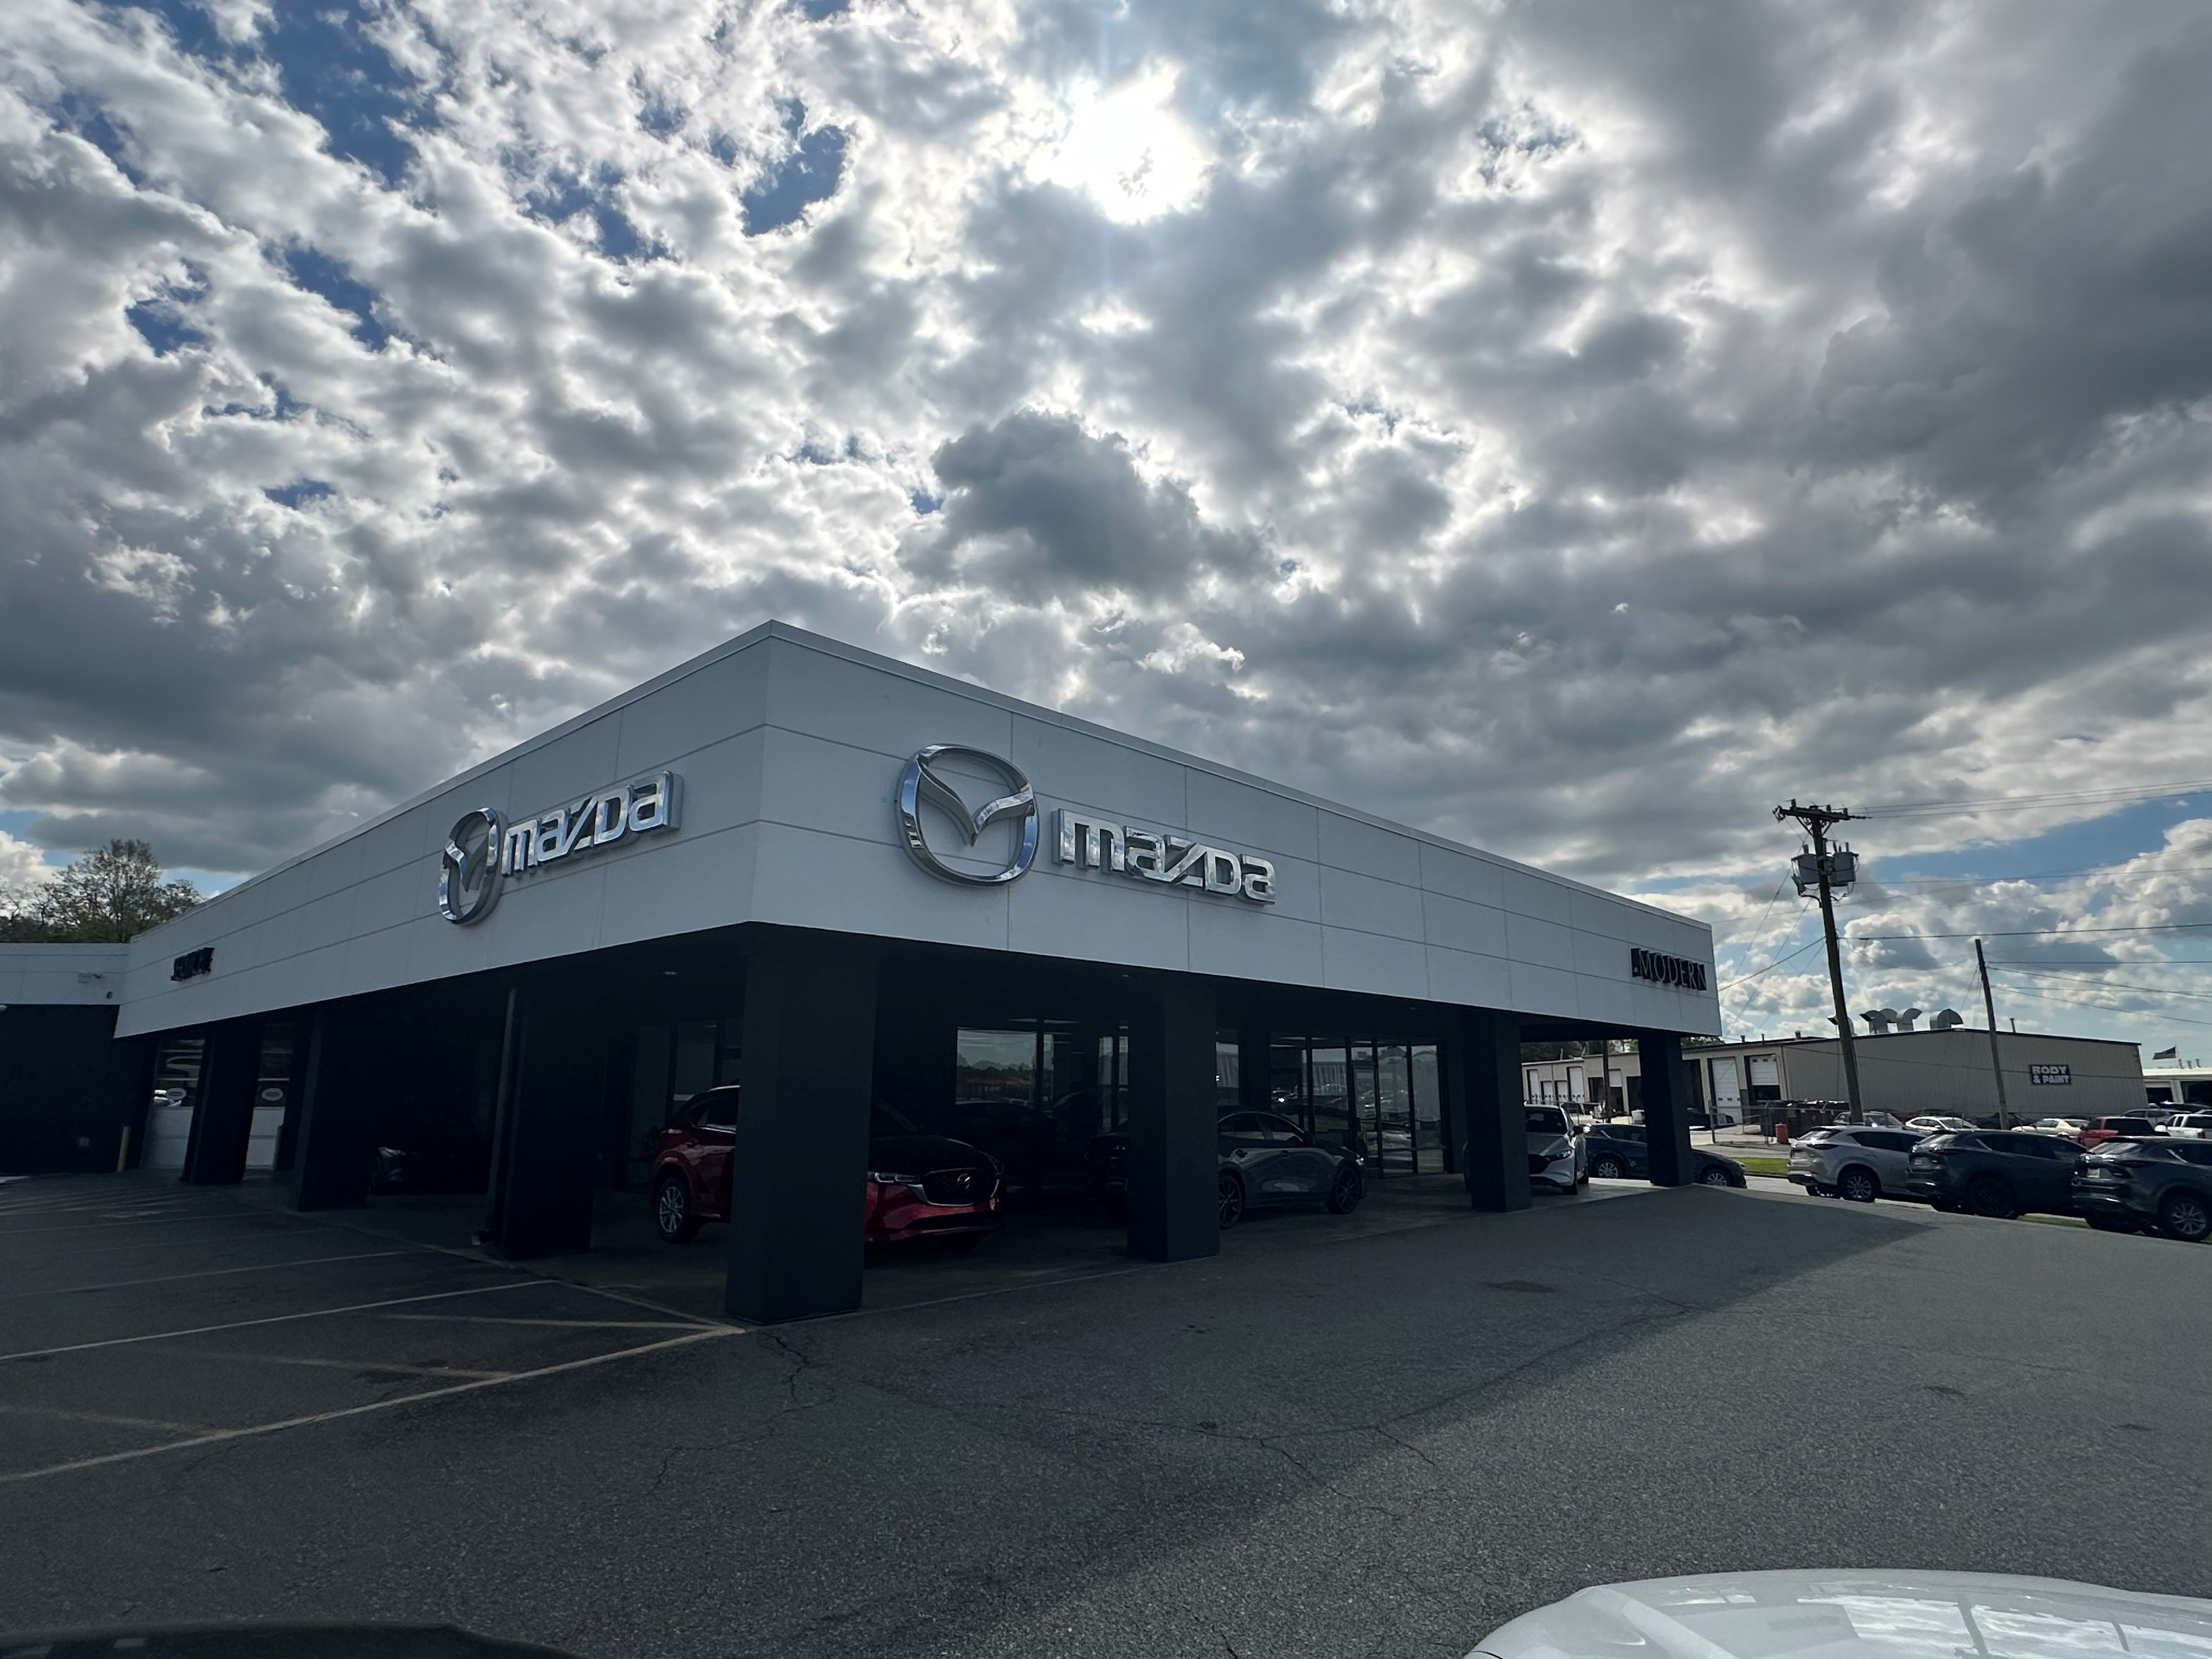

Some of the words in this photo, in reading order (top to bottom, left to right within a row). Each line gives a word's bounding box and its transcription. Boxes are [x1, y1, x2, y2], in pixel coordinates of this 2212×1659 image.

[1631, 948, 1707, 991] MODERN
[2032, 1065, 2067, 1074] BODY
[2033, 1075, 2041, 1084] &
[2042, 1075, 2069, 1084] PAINT
